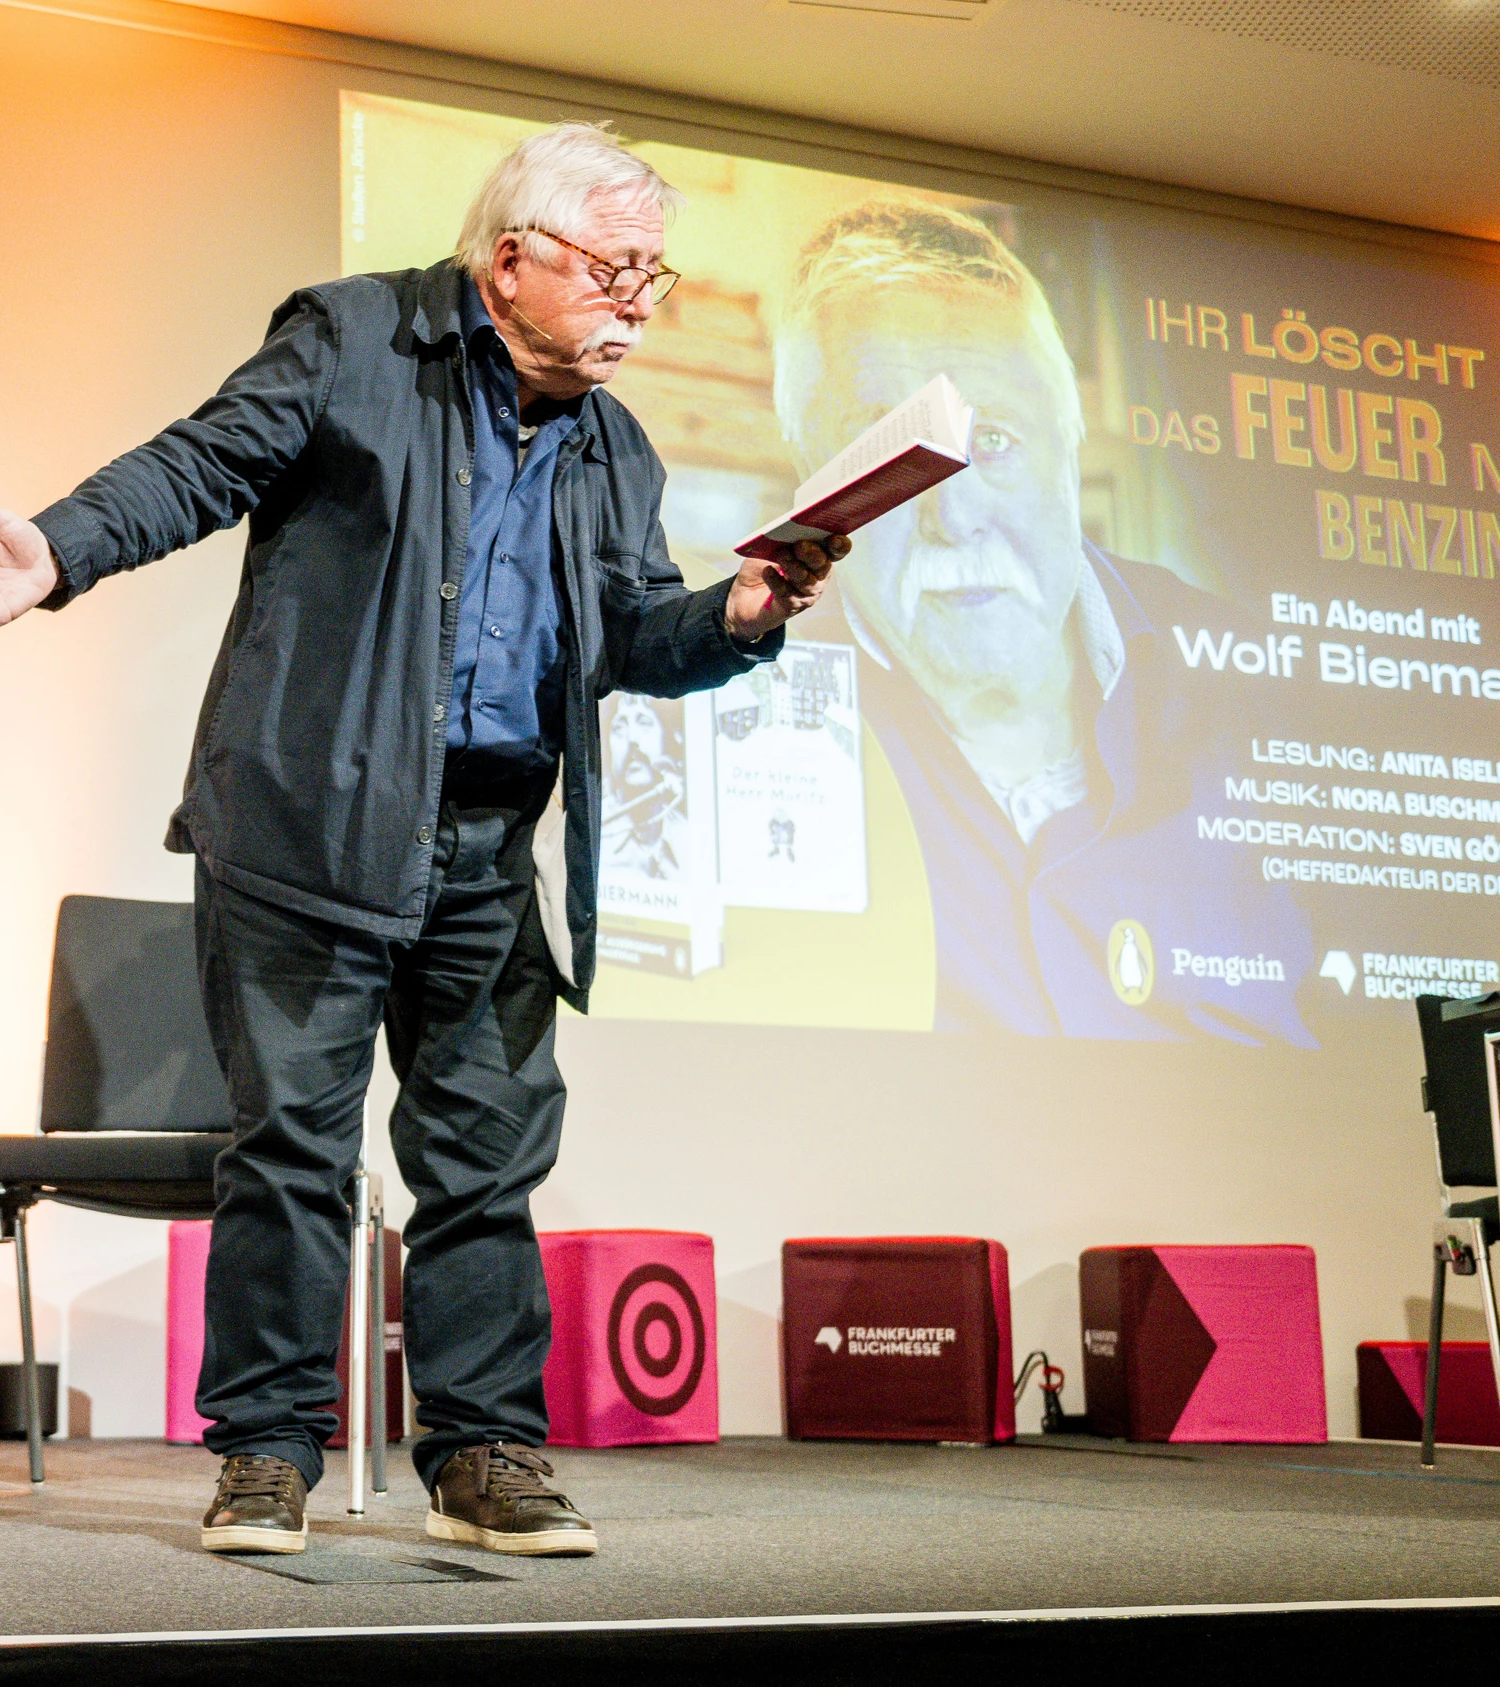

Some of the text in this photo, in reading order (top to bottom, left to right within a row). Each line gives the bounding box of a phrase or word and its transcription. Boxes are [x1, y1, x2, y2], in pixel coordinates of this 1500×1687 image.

[1145, 298, 1485, 389] IHR LÖSCHT
[1127, 405, 1221, 455] DAS
[1230, 372, 1447, 486] FEUER
[1315, 489, 1500, 580] BENZIN
[1270, 592, 1482, 645] Ein Abend mit
[1172, 625, 1304, 678] Wolf
[1251, 738, 1376, 772] LESUNG:
[1380, 750, 1451, 780] ANITA
[1225, 777, 1329, 808] MUSIK:
[1332, 785, 1402, 816] NORA
[1197, 815, 1396, 855] MODERATION:
[1400, 831, 1463, 860] SVEN
[1262, 856, 1438, 892] (CHEFREDAKTEUR
[1441, 870, 1481, 894] DER
[1171, 948, 1286, 988] Penguin
[1362, 952, 1500, 983] FRANKFURTER
[1364, 975, 1483, 1000] BUCHMESSE
[847, 1327, 957, 1342] FRANKFURTER
[848, 1341, 942, 1357] BUCHMESSE
